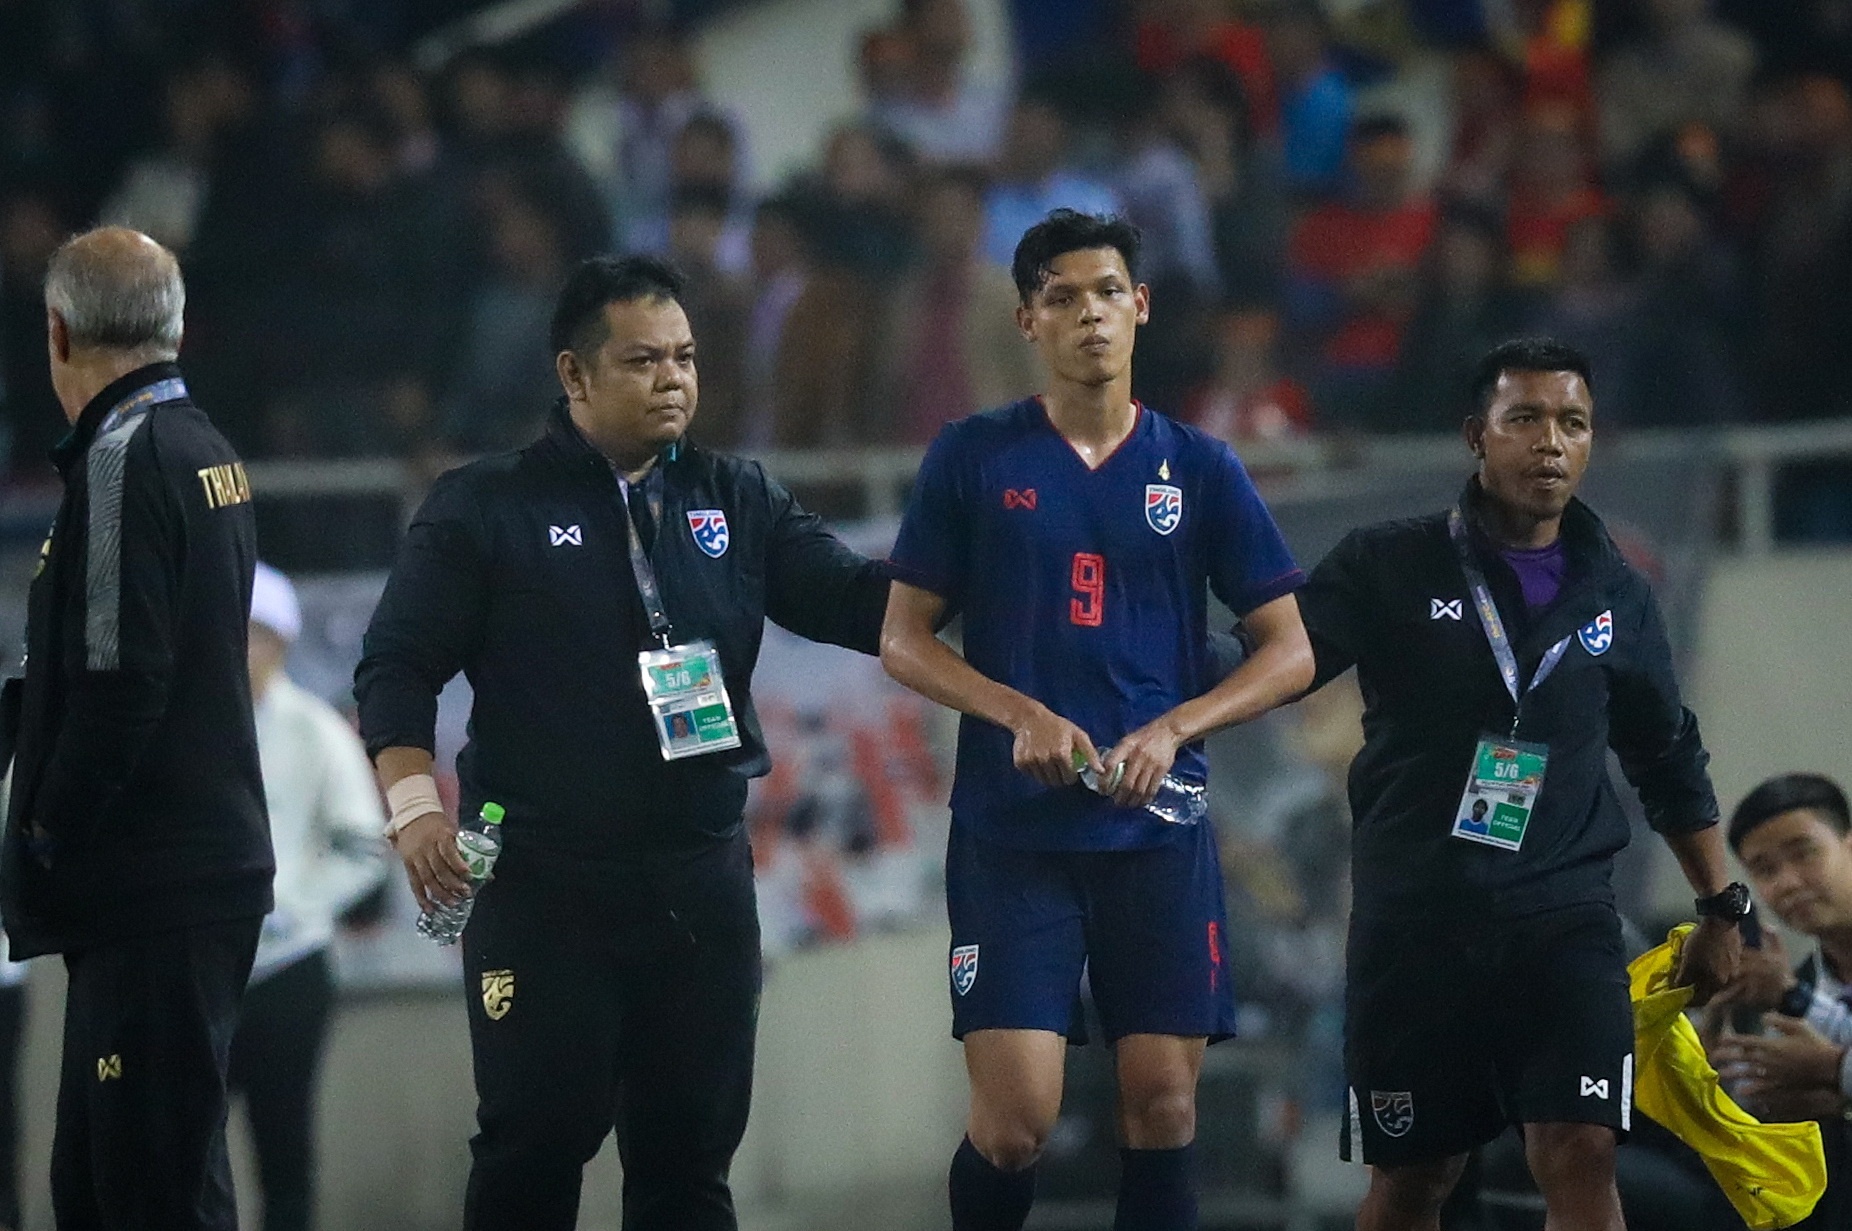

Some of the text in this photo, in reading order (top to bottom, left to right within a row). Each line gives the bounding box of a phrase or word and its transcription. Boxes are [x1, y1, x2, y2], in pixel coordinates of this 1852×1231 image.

[1069, 552, 1104, 627] 9
[664, 669, 692, 689] 5/6
[1493, 762, 1520, 779] 5/6
